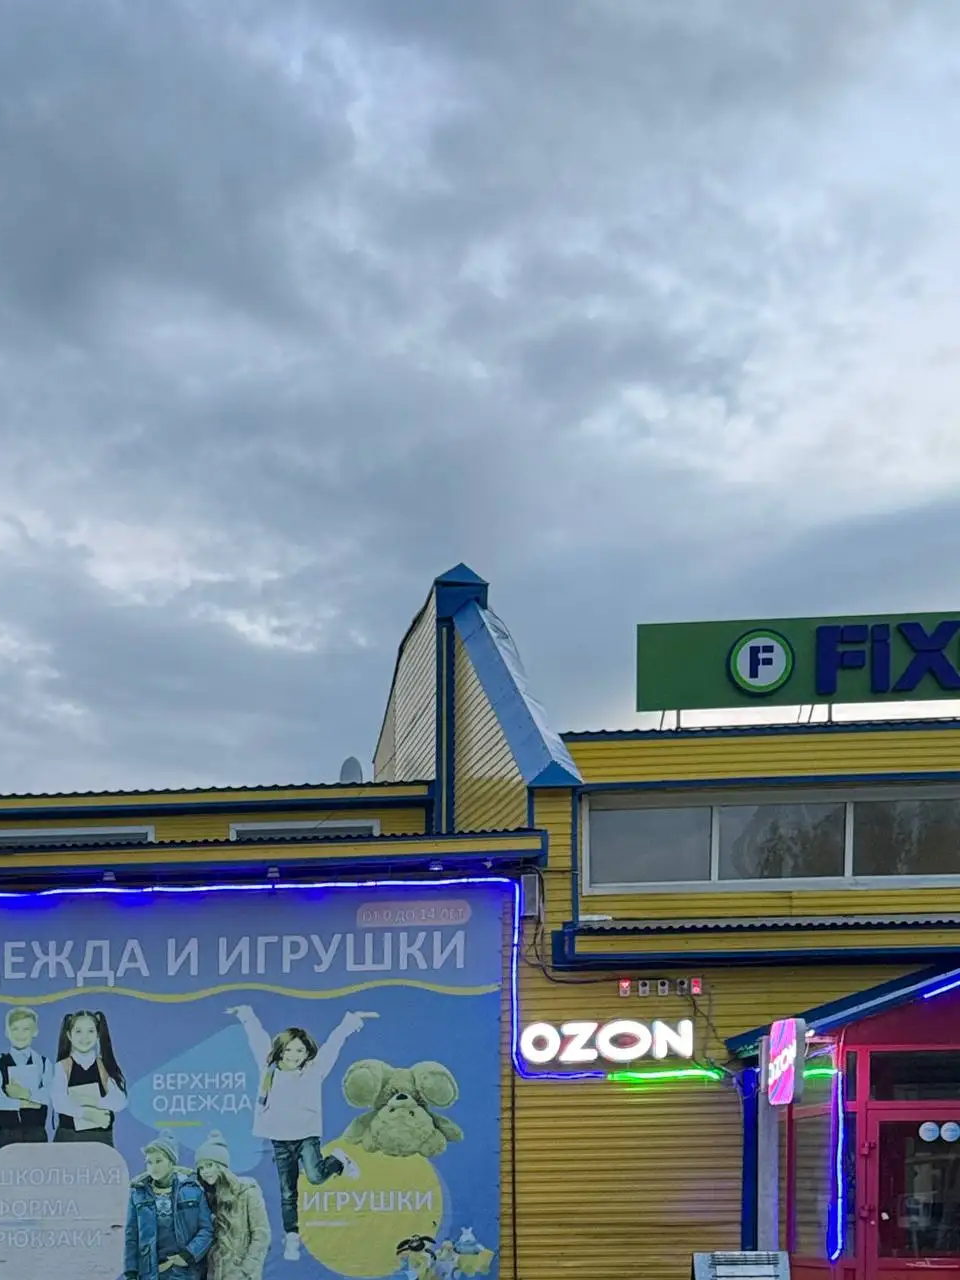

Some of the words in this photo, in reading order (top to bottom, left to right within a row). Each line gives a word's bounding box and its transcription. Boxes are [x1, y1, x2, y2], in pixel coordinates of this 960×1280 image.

[167, 937, 199, 976] И
[218, 930, 465, 975] ИГРУШКИ
[520, 1019, 693, 1064] OZON
[153, 1072, 246, 1091] ВЕРХНЯЯ
[153, 1094, 253, 1115] ОДЕЖДА
[303, 1190, 434, 1212] ИГРУШКИ
